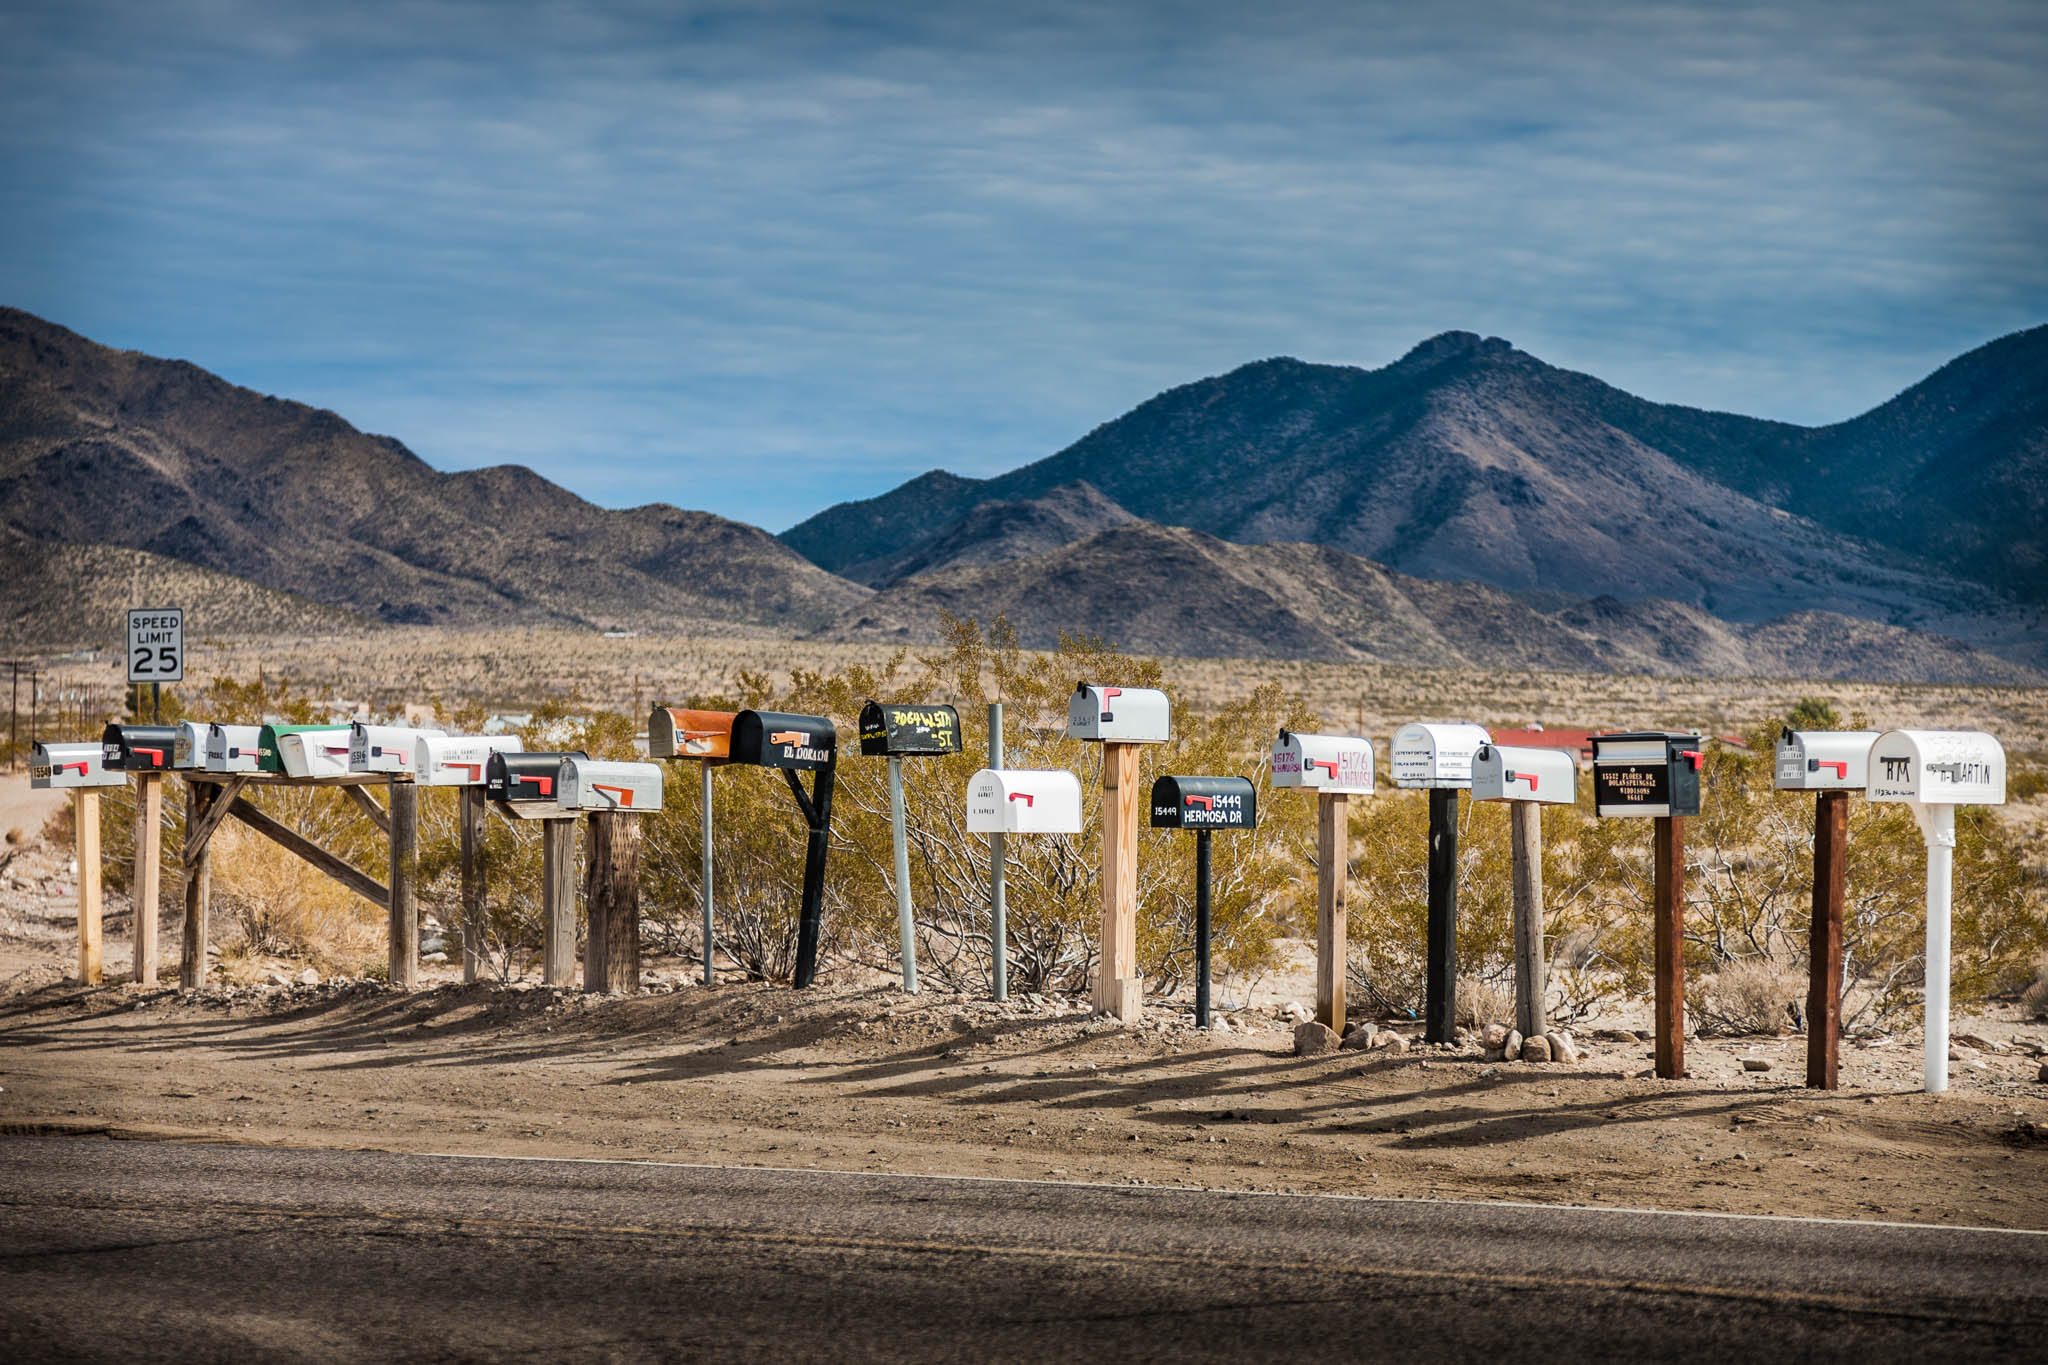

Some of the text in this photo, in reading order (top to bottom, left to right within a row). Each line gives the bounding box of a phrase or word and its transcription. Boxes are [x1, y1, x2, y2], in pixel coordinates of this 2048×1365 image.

[132, 617, 179, 629] SPEED
[137, 632, 173, 644] LIMIT
[133, 647, 178, 673] 25
[784, 745, 794, 759] EL
[1274, 752, 1295, 763] 15176
[1337, 751, 1369, 770] 15176
[1210, 795, 1241, 809] 15449
[1155, 807, 1177, 816] 15449
[1184, 810, 1243, 823] HERMOSA DR
